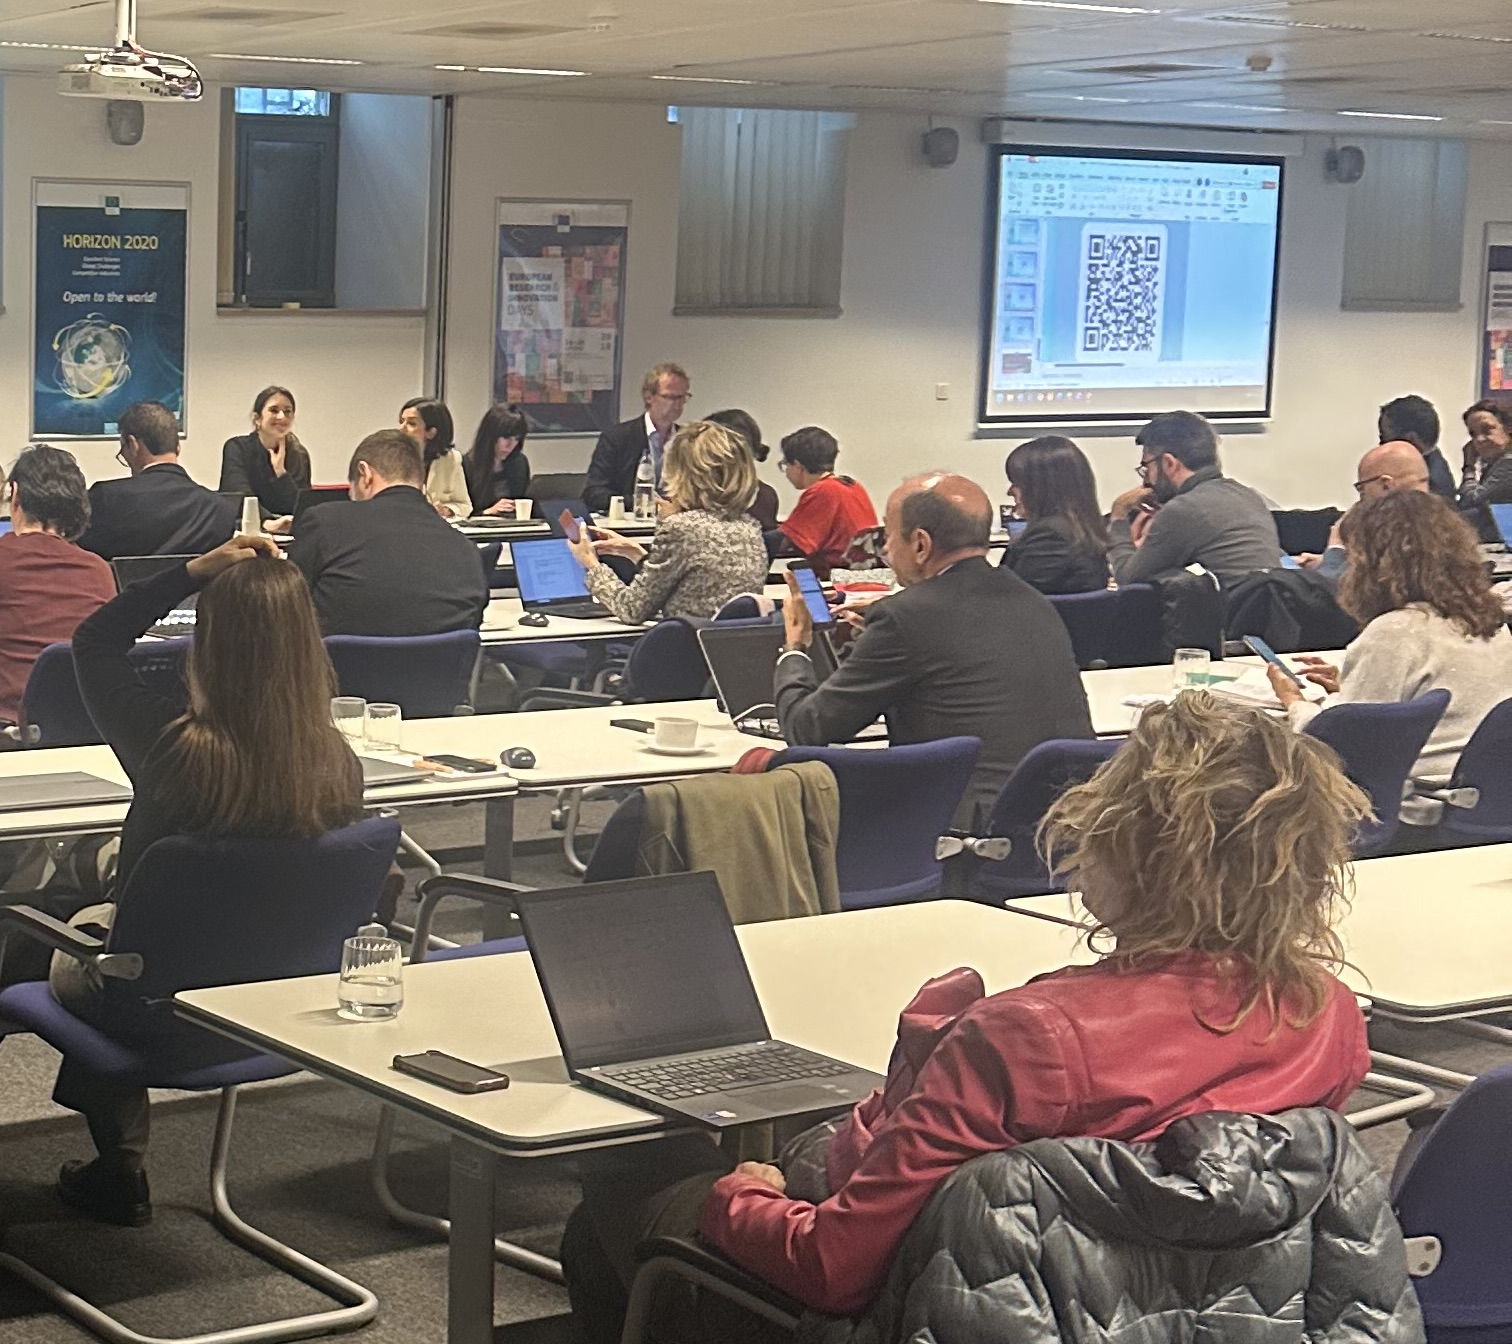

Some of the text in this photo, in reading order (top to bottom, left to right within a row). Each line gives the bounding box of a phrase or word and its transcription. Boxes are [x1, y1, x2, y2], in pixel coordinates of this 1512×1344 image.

[63, 234, 159, 250] HORIZON 2020
[62, 291, 158, 305] Open to the world!
